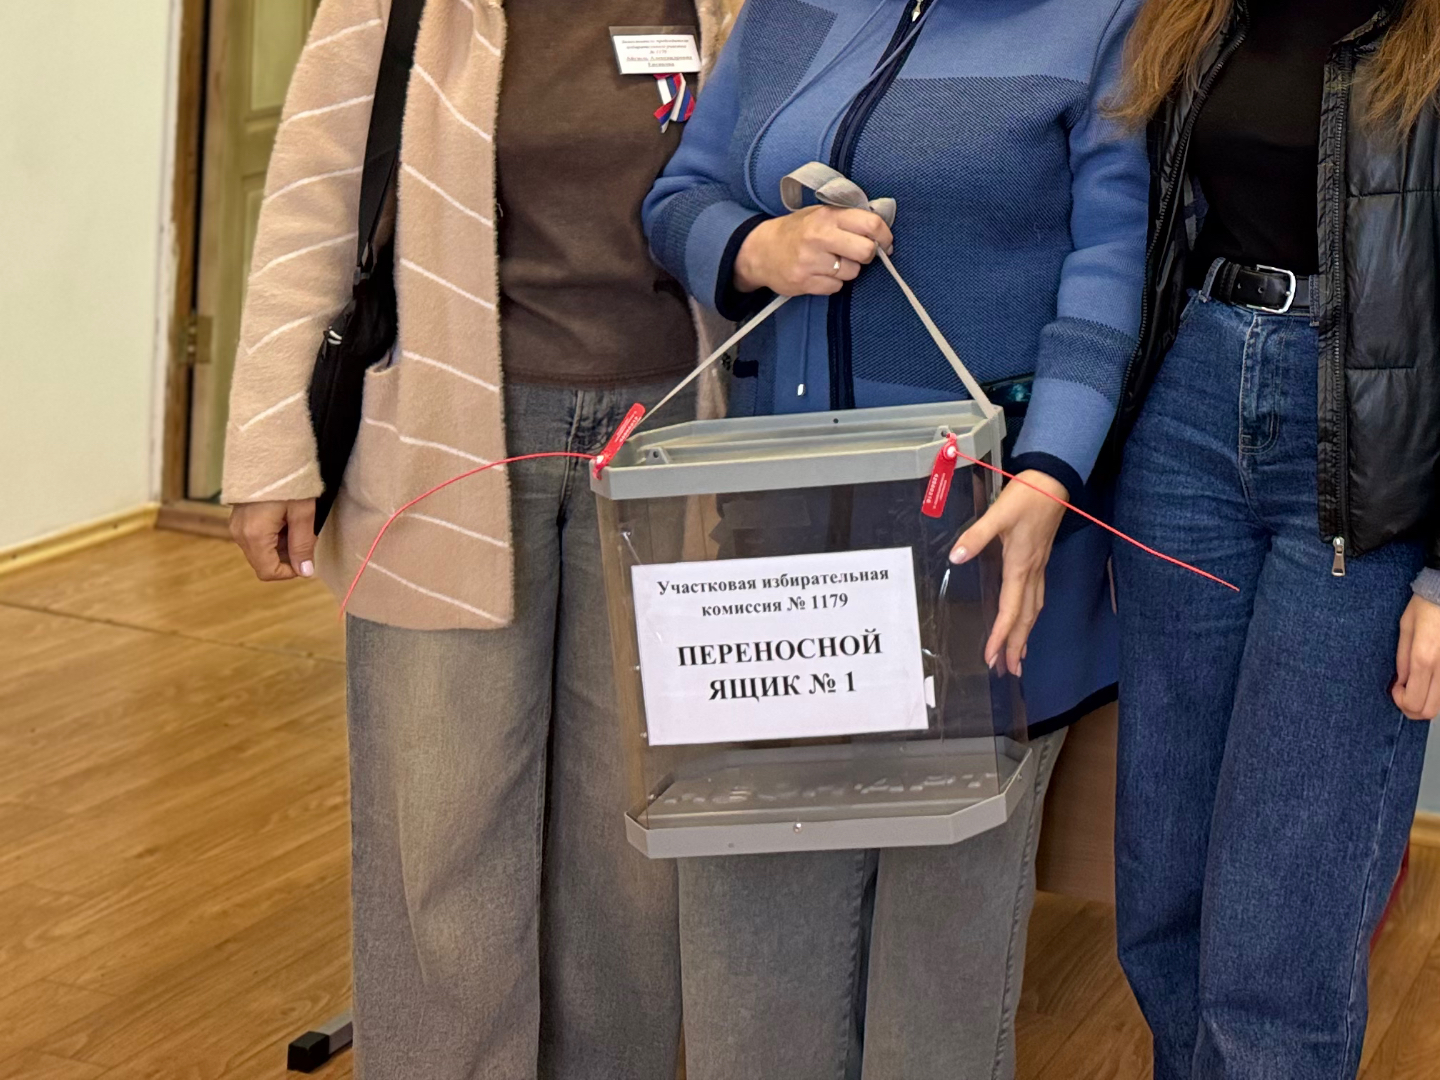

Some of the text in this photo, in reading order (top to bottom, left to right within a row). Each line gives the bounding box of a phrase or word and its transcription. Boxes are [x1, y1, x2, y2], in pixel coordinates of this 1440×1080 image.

[657, 569, 889, 595] Участковая избирательная
[702, 593, 849, 617] комиссия № 1179
[677, 628, 883, 666] ПЕРЕНОСНОЙ
[709, 672, 856, 702] ЯЩИК № 1
